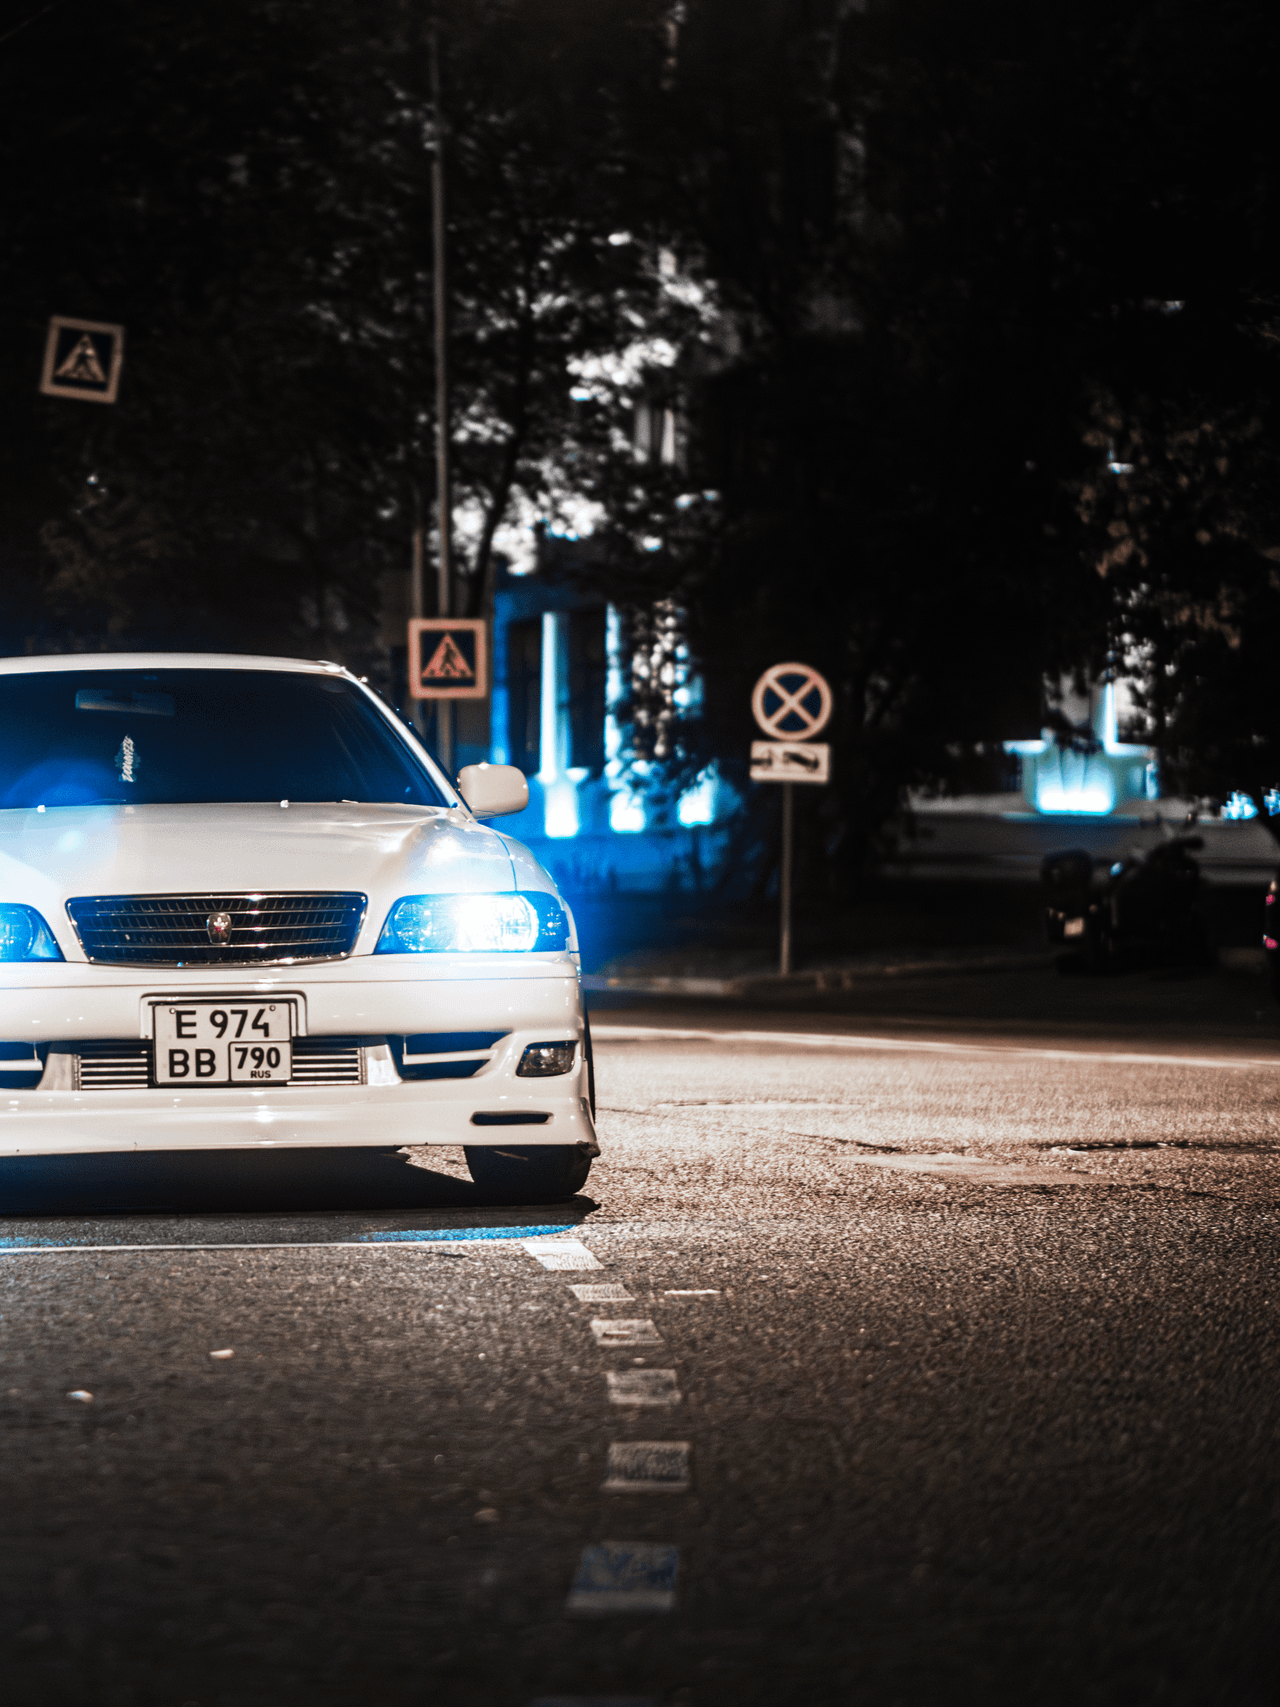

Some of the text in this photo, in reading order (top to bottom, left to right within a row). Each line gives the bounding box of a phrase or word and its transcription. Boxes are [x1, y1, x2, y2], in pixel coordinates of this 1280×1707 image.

[209, 1009, 270, 1039] 974
[168, 1048, 217, 1078] BB
[234, 1047, 281, 1070] 790
[250, 1070, 272, 1079] RUS
